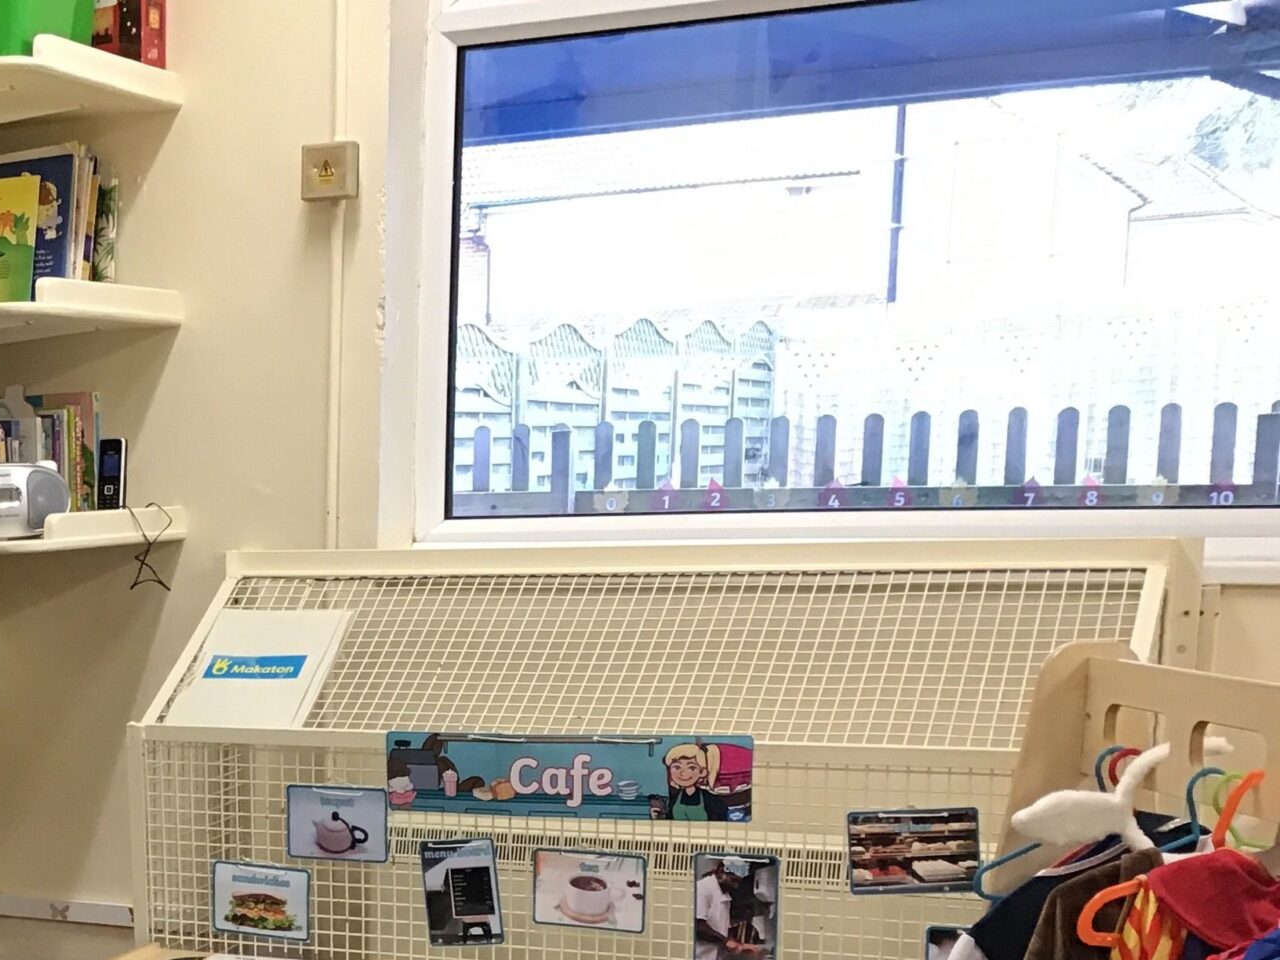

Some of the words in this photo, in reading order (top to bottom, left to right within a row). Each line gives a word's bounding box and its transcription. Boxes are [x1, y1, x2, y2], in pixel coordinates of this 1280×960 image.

[661, 494, 671, 509] 1
[710, 491, 721, 507] 2
[766, 493, 776, 507] 3
[827, 493, 840, 509] 4
[893, 491, 906, 507] 5
[952, 493, 963, 507] 6
[1023, 492, 1036, 507] 7
[1084, 490, 1098, 506] 8
[1151, 491, 1165, 506] 9
[1208, 490, 1234, 506] 10
[230, 664, 295, 675] Makaton
[509, 753, 614, 808] Cafe
